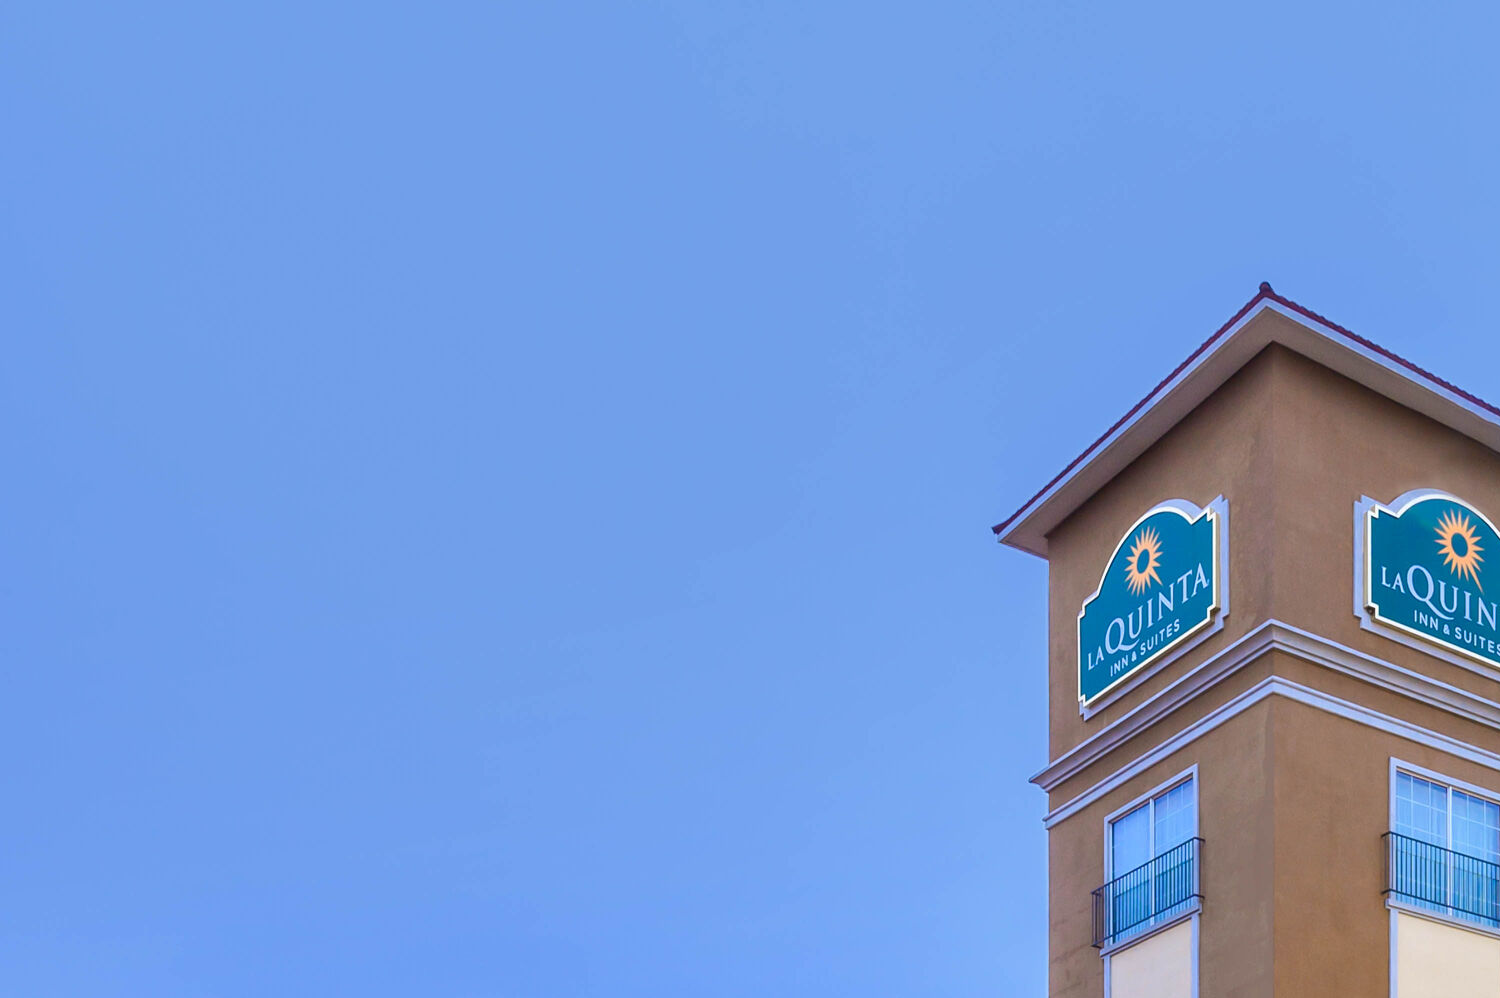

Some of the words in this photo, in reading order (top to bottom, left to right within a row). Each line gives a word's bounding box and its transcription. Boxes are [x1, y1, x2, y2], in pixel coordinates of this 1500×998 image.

[1381, 566, 1406, 594] LA
[1087, 645, 1104, 671] LA
[1105, 563, 1209, 654] QUINTA
[1414, 610, 1439, 631] INN
[1443, 624, 1450, 635] &
[1110, 654, 1129, 677] INN
[1131, 650, 1137, 662] &
[1140, 618, 1180, 656] SUITES
